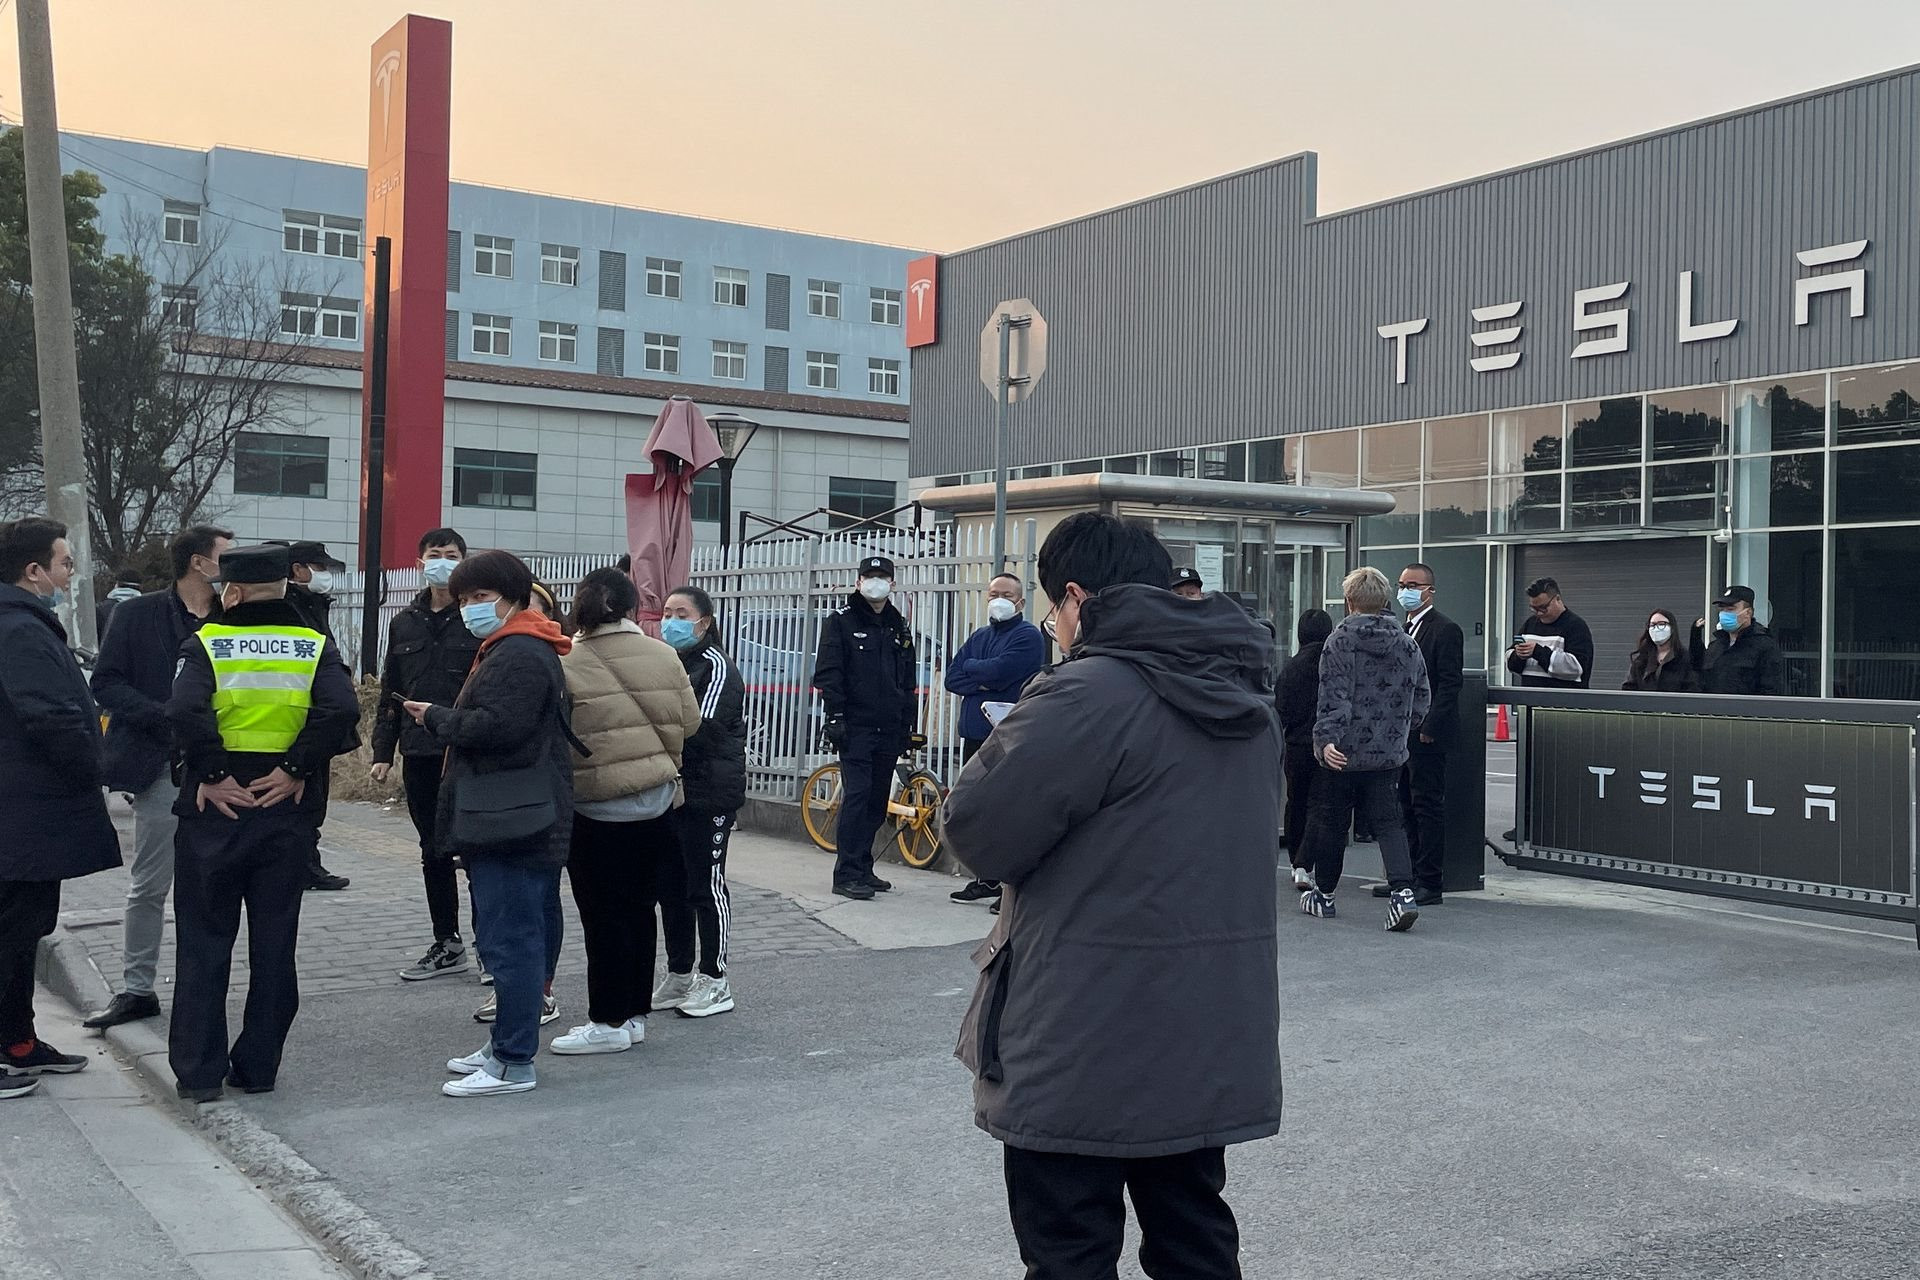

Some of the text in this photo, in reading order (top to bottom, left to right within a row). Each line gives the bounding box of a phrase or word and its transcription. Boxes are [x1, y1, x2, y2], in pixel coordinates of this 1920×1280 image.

[371, 170, 401, 203] TESLA
[1377, 239, 1869, 384] TESLA
[211, 638, 316, 658] 警 POLICE 察
[1587, 765, 1837, 822] TESLA
